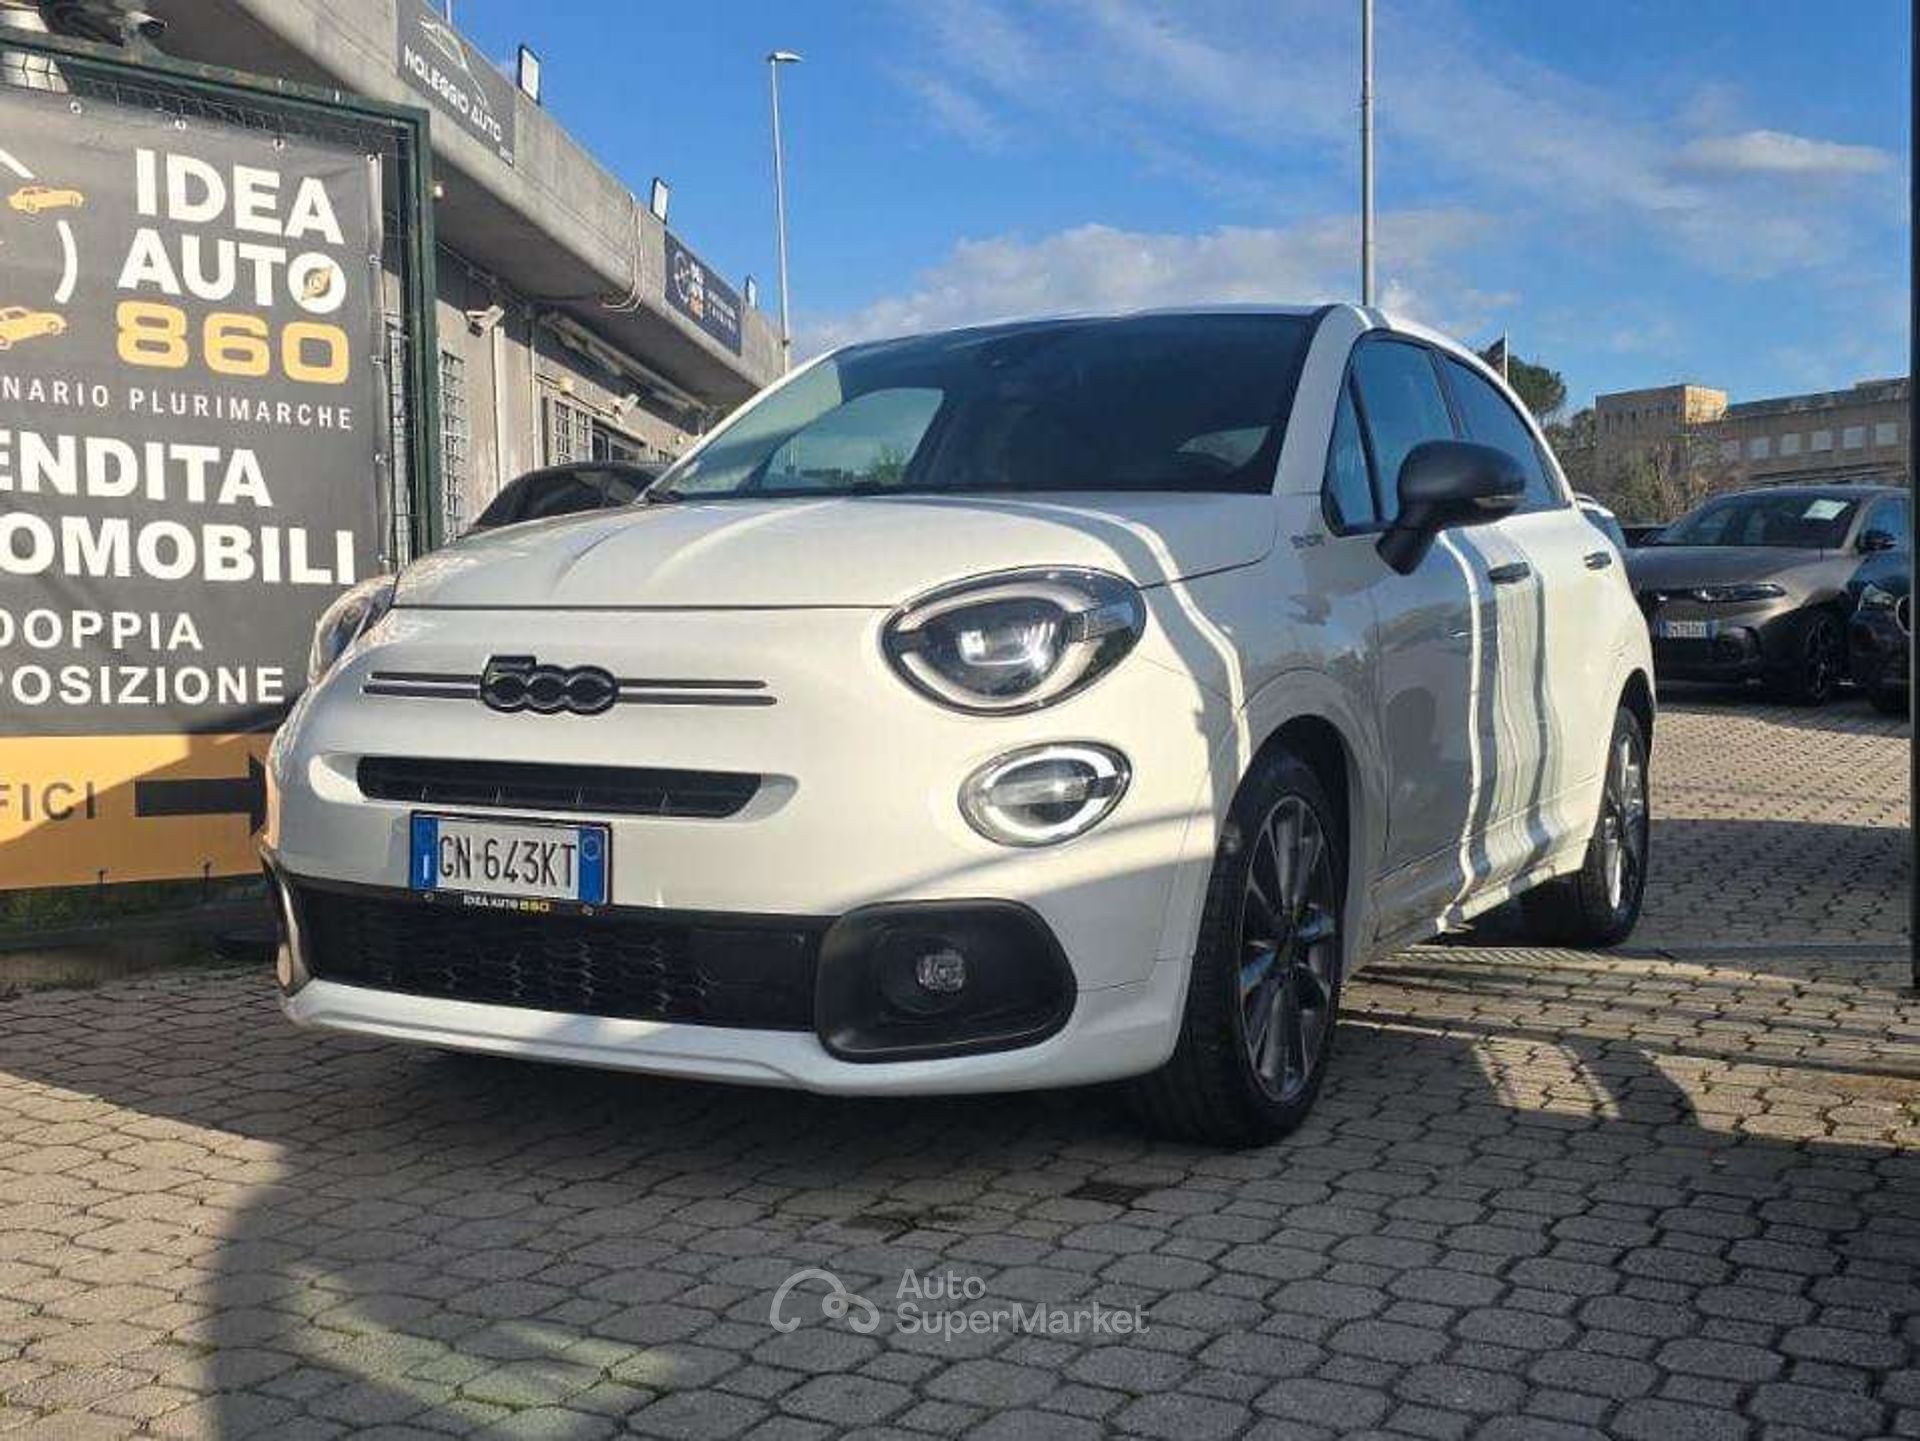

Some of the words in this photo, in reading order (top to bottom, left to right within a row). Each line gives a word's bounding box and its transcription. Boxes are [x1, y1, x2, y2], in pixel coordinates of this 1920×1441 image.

[471, 104, 503, 143] AUTO
[135, 148, 345, 245] IDEA
[117, 227, 347, 315] AUTO
[115, 300, 350, 385] 860
[2, 375, 110, 408] NARIO
[129, 388, 353, 432] PLURIMARCHE
[0, 512, 356, 586] OMOBILI
[0, 664, 285, 705] OSIZIONE
[482, 654, 617, 716] 500
